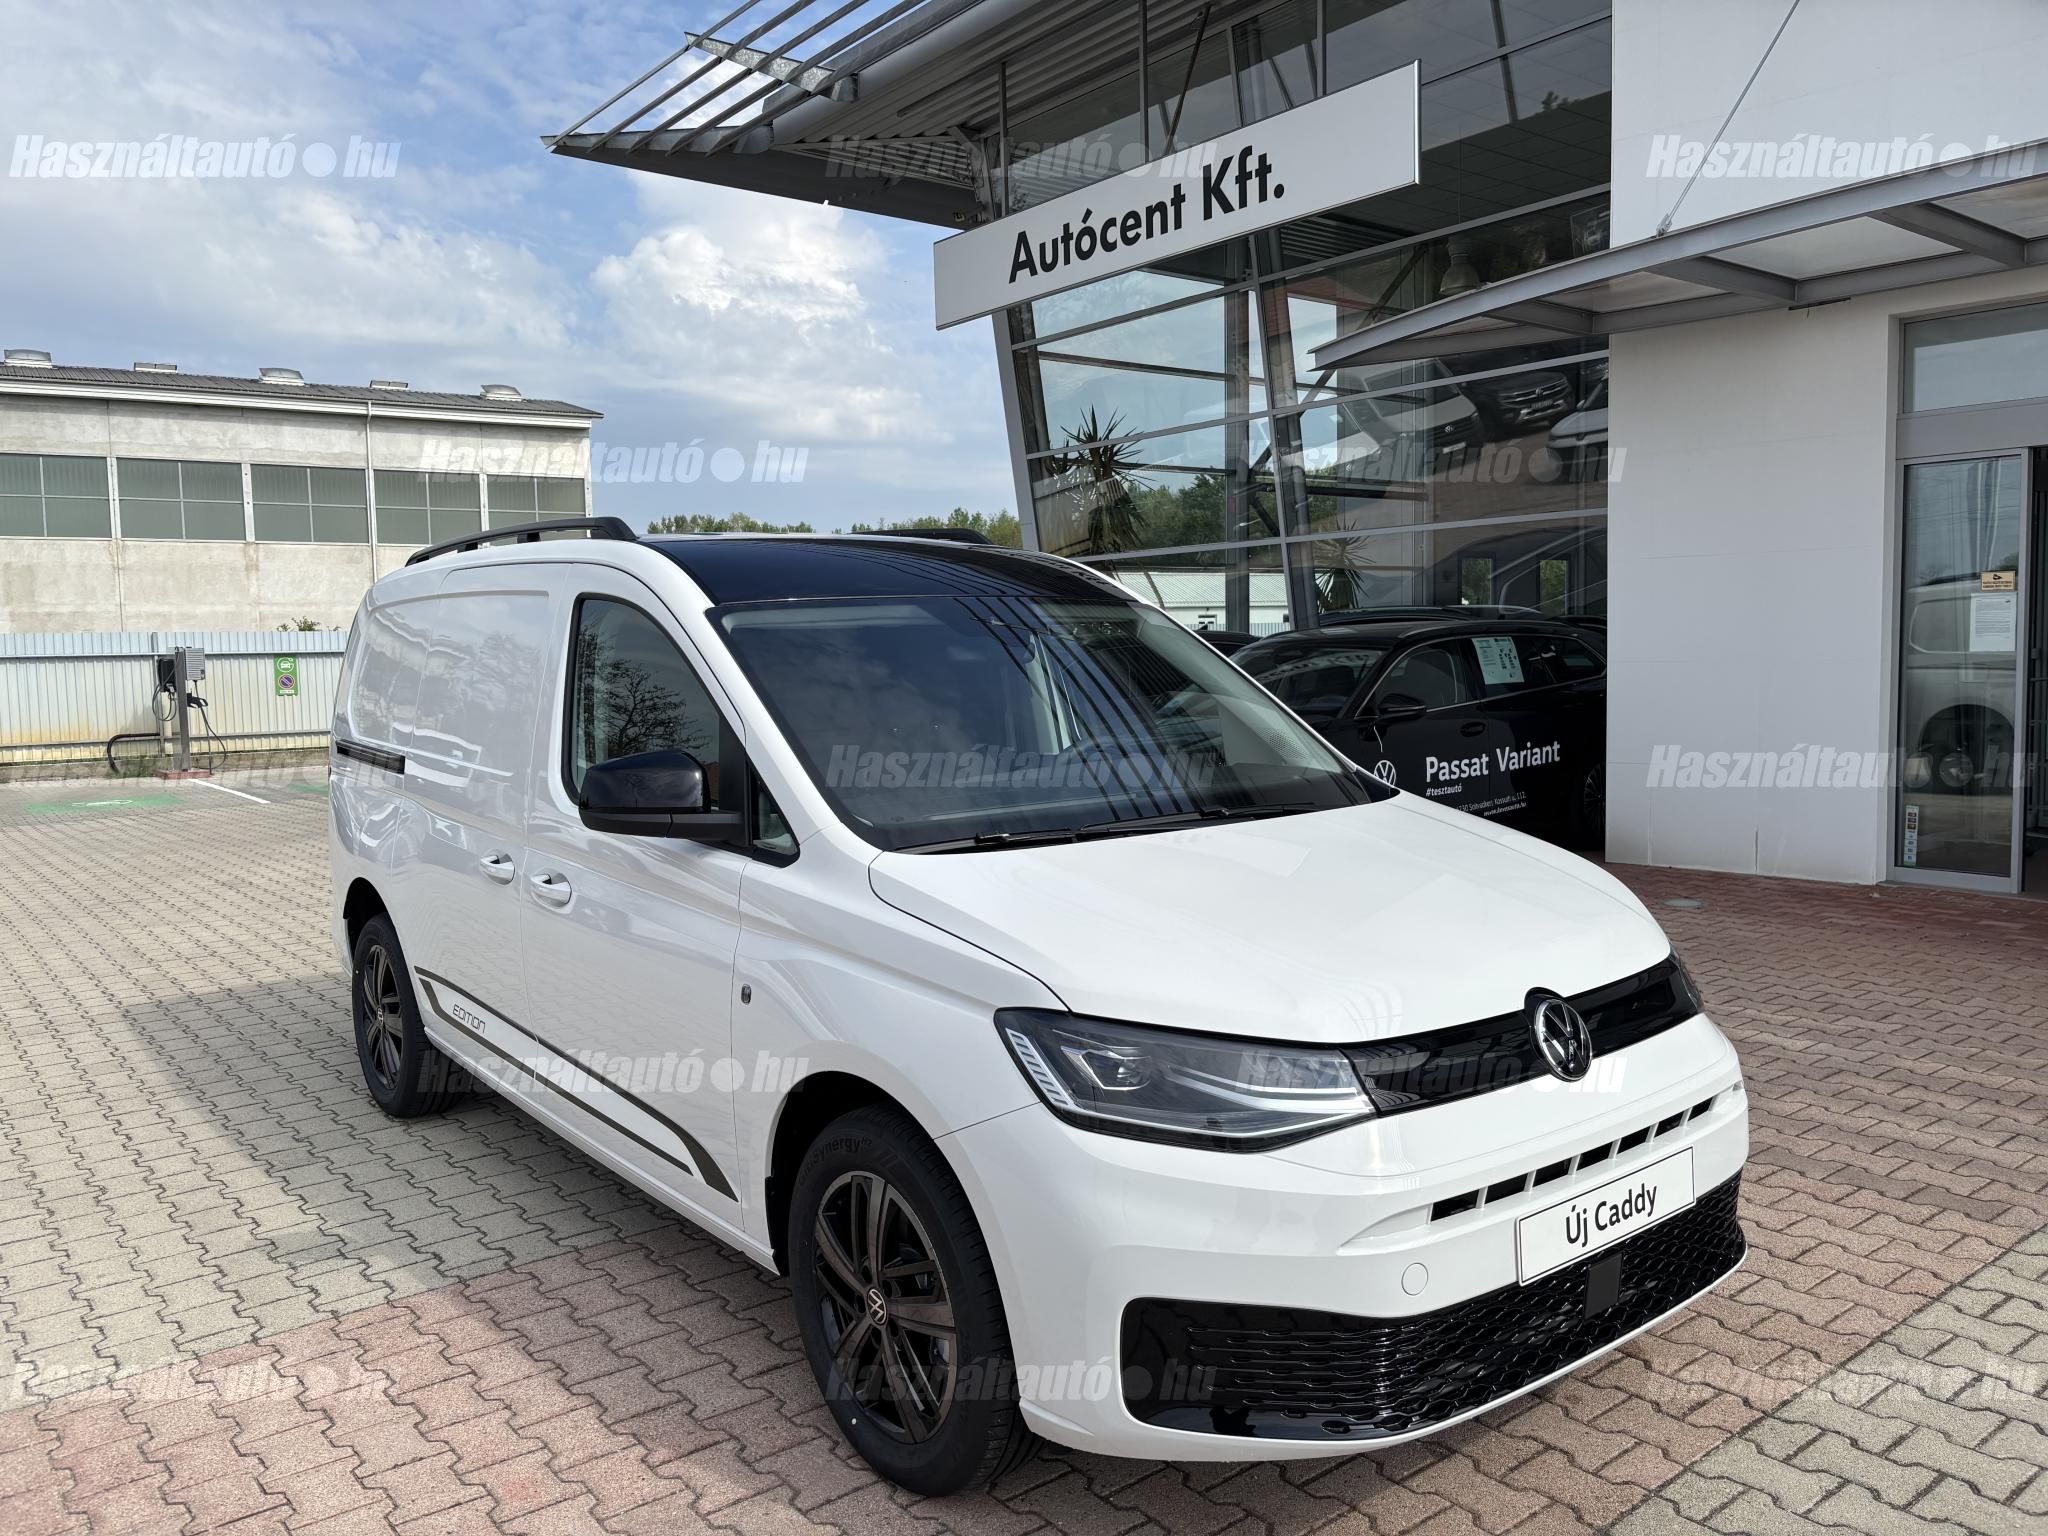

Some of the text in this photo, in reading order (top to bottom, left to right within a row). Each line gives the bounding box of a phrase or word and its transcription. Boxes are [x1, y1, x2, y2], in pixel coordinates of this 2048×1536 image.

[1008, 145, 1285, 284] Autócent Kft.
[1425, 741, 1561, 783] Passat Variant
[1425, 783, 1463, 797] #tesztautó
[452, 1003, 487, 1034] EDITION
[1565, 1182, 1659, 1248] Új Caddy
